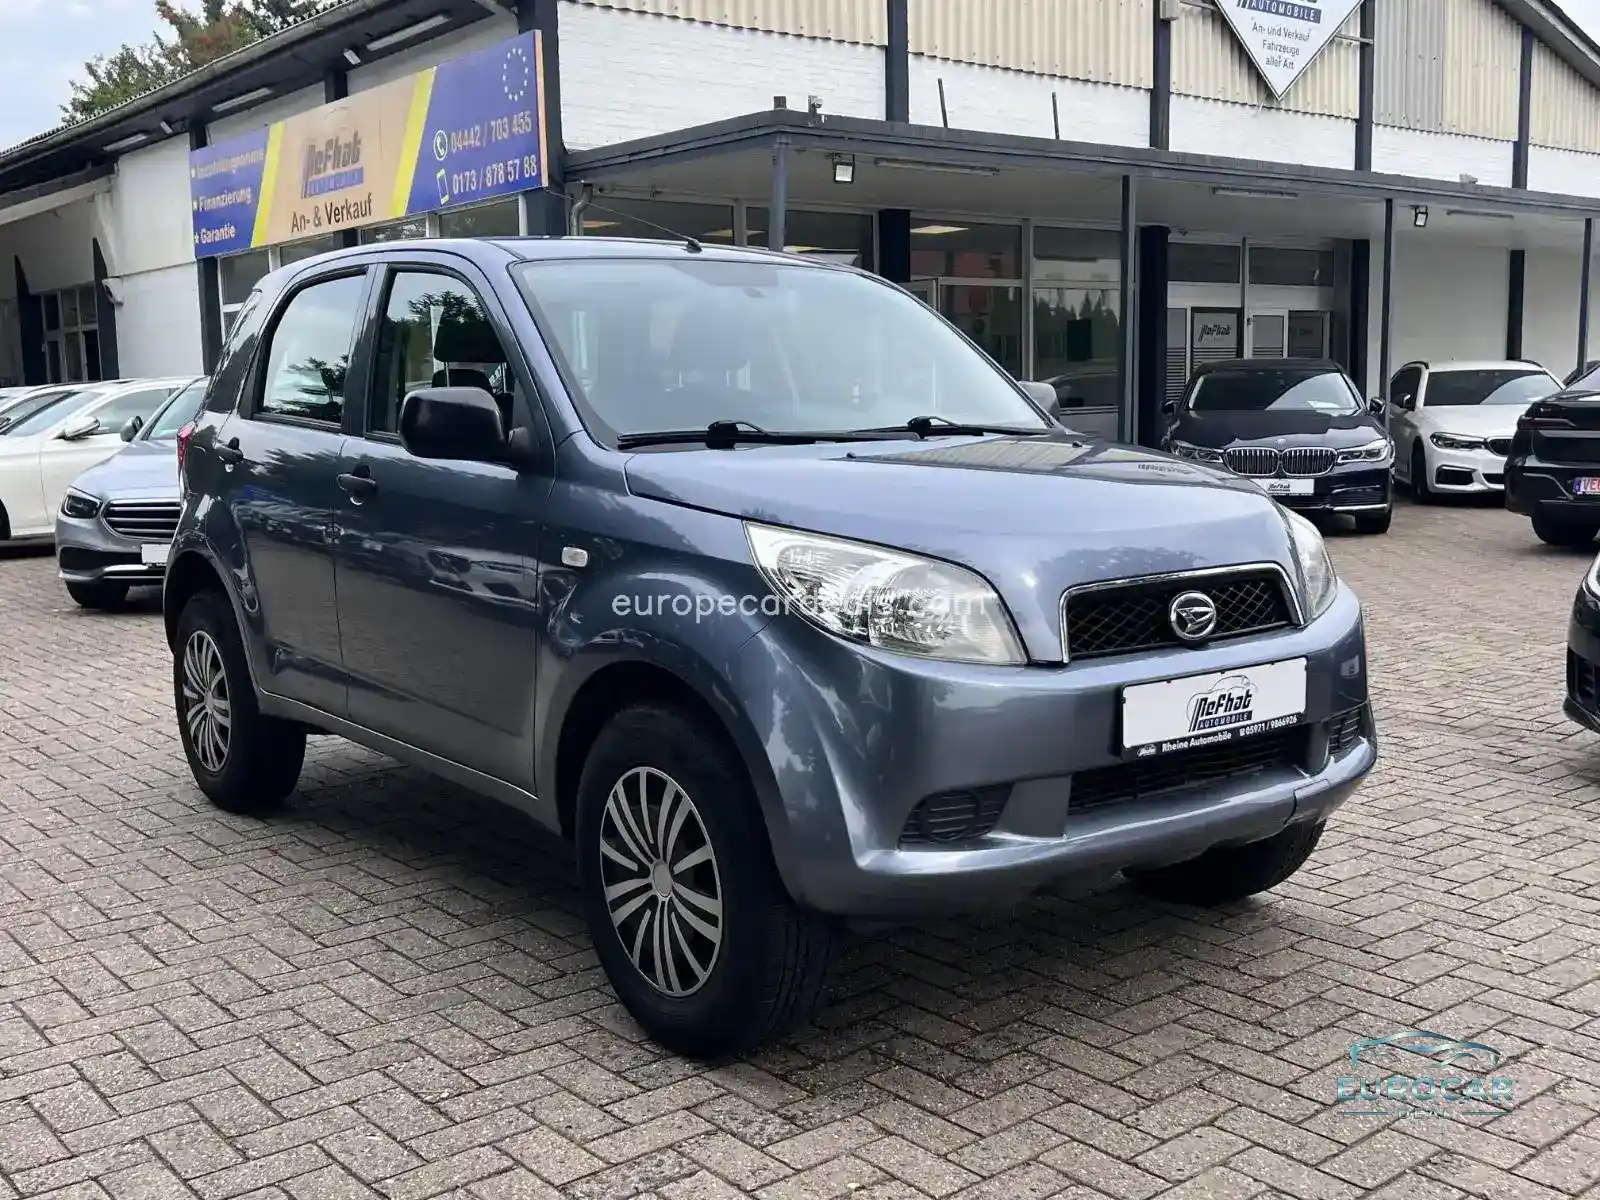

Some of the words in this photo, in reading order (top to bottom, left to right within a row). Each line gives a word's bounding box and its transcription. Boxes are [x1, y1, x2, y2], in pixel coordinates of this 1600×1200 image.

[1250, 0, 1316, 20] AUTOMOBILE
[1267, 26, 1282, 37] und
[1283, 27, 1311, 42] Verkauf
[1262, 39, 1300, 57] Fahrzeuge
[1265, 56, 1282, 67] aller
[1283, 59, 1295, 70] Art
[450, 125, 481, 154] 04442
[491, 117, 510, 142] 703
[512, 110, 532, 135] 455
[452, 169, 477, 195] 0173
[486, 162, 505, 187] 878
[507, 158, 521, 182] 57
[523, 154, 537, 178] 88
[199, 186, 252, 212] Finanzierung
[313, 205, 322, 228] &
[325, 192, 372, 225] Verkauf
[200, 222, 236, 244] Garantie
[1583, 478, 1600, 491] VE
[1199, 712, 1248, 729] AUTOMOBILE
[1161, 739, 1189, 753] Rheine
[1189, 730, 1232, 747] Automobile
